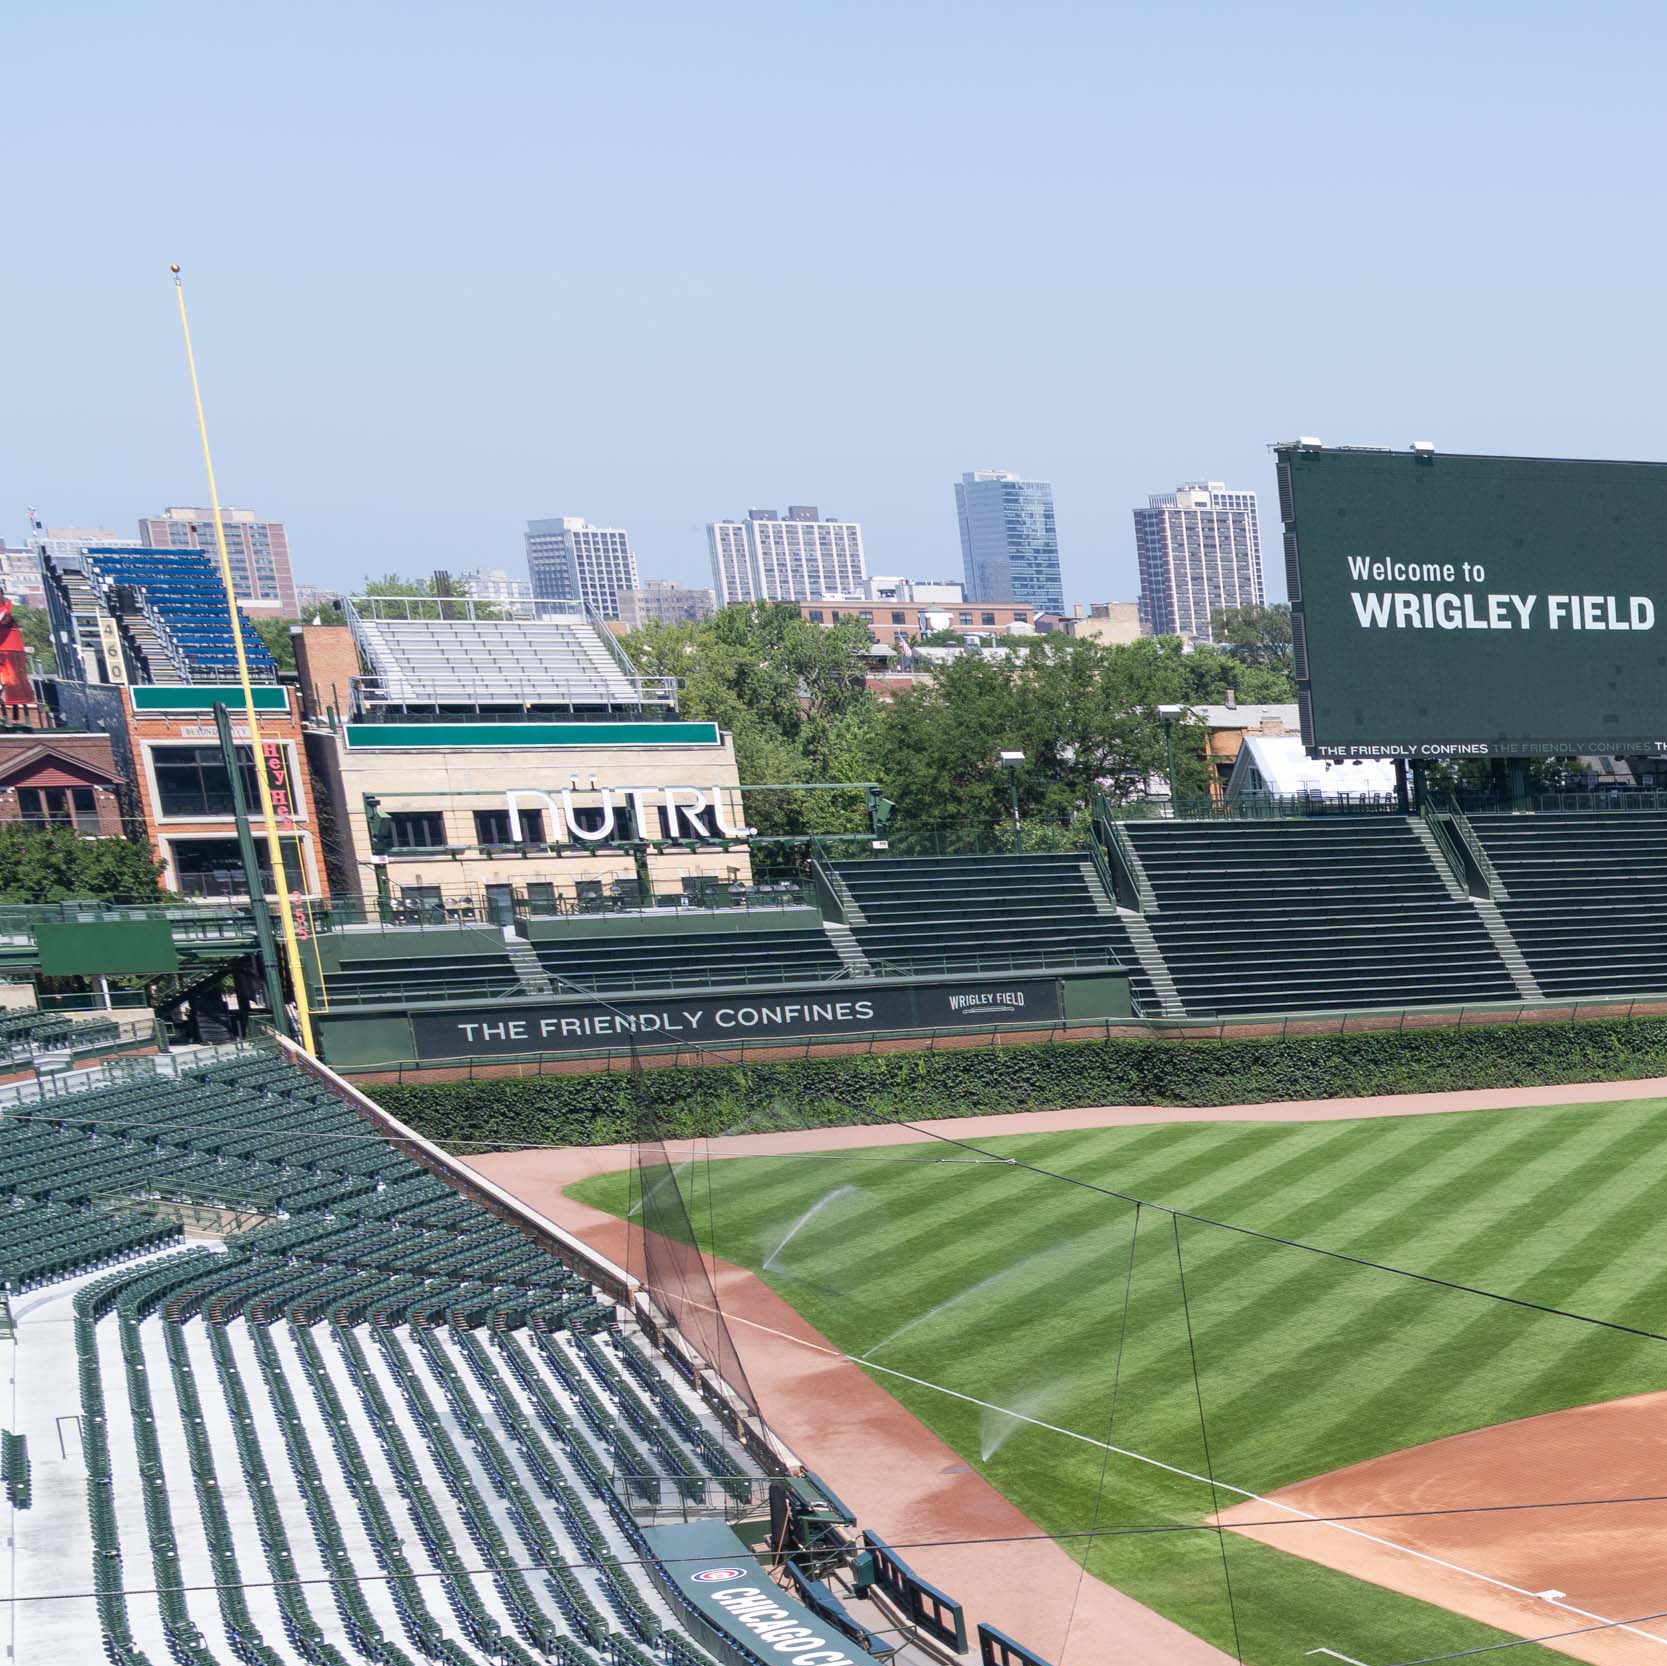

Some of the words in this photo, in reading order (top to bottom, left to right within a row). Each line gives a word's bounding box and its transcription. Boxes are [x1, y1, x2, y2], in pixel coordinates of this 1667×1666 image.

[1348, 556, 1453, 583] Welcome
[1462, 560, 1485, 583] to
[1350, 592, 1536, 630] WRIGLEY
[1549, 595, 1655, 631] FIELD
[104, 625, 121, 677] 460
[263, 743, 285, 785] Hey
[1319, 746, 1346, 756] THE
[1350, 744, 1417, 756] FRIENDLY
[1421, 744, 1488, 755] CONFINES
[949, 993, 995, 1011] WRIGLEY
[997, 990, 1025, 1008] FIELD
[457, 1022, 530, 1043] THE
[540, 1010, 703, 1040] FRIENDLY
[714, 1001, 874, 1029] CONFINES
[710, 1587, 826, 1651] CHICAGO
